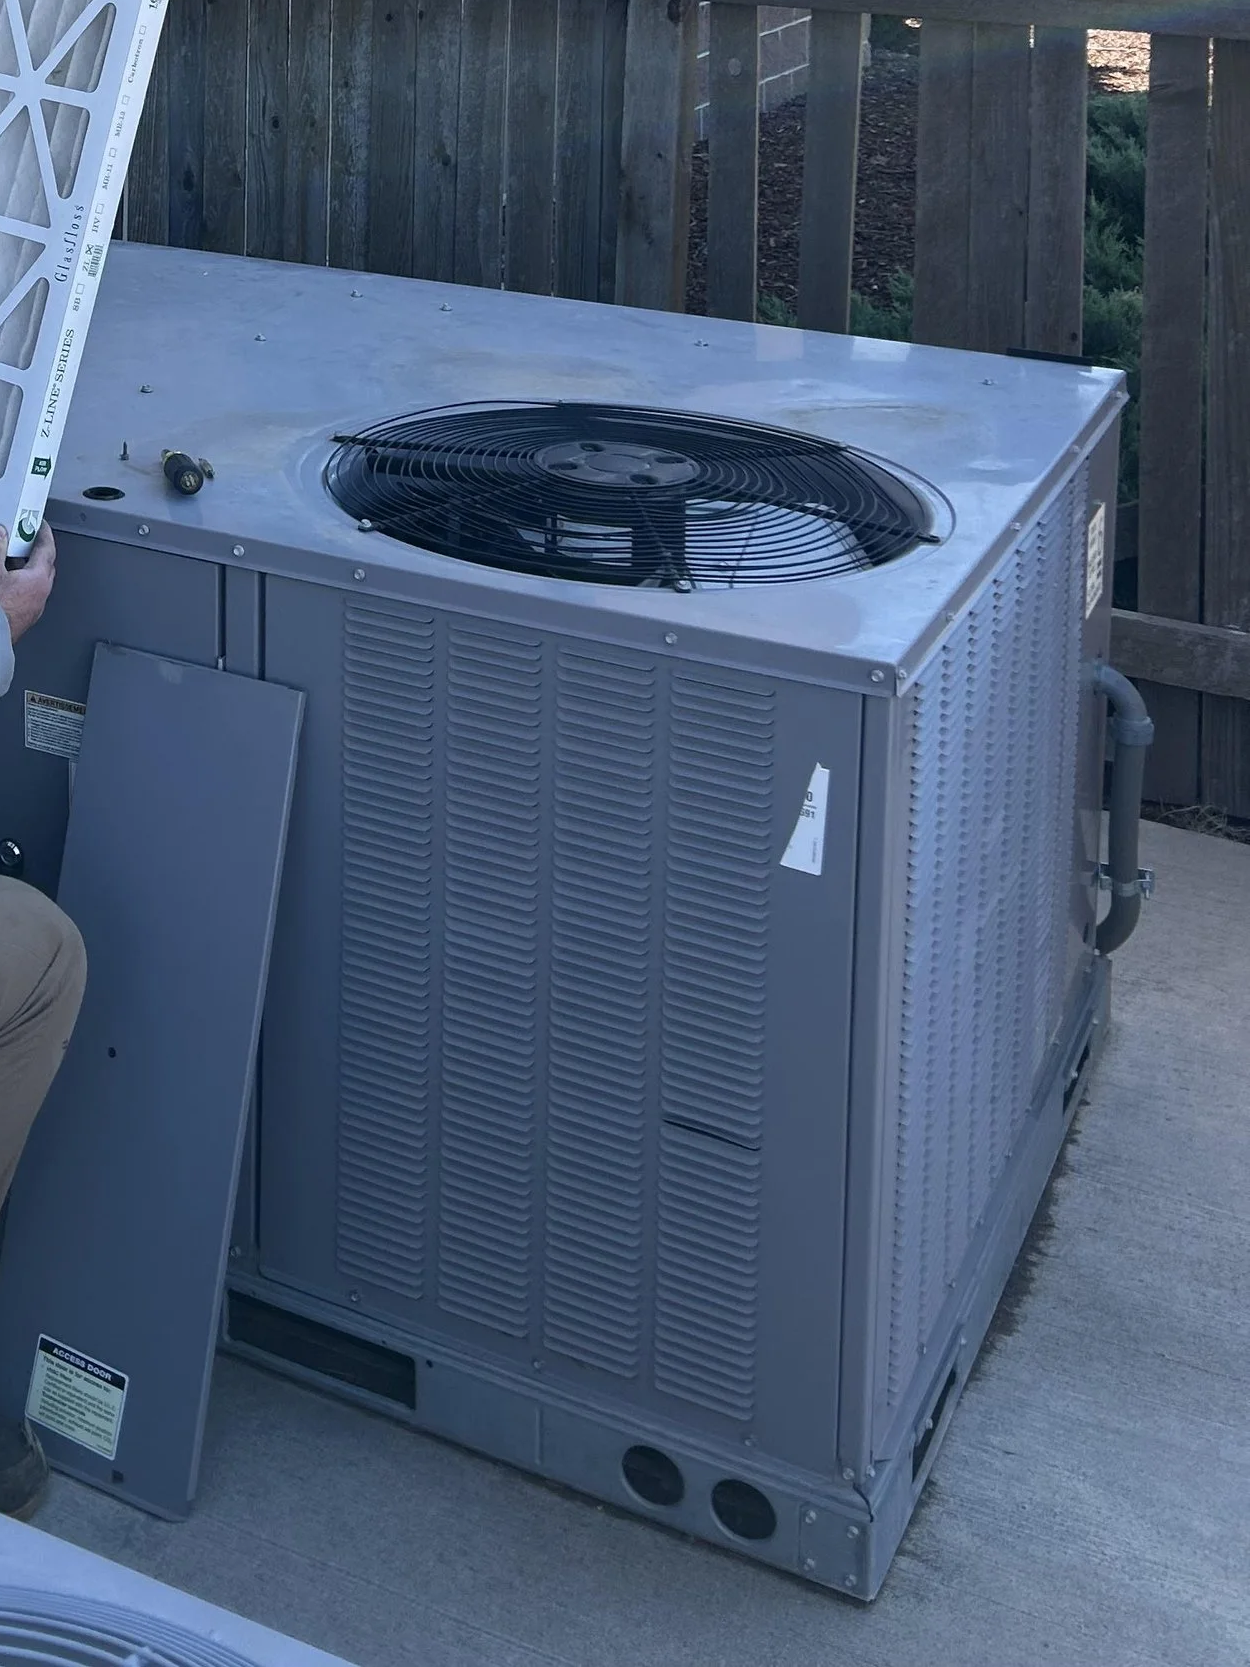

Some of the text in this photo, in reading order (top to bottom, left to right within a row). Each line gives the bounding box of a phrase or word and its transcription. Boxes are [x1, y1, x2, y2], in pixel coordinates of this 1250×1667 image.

[53, 204, 85, 283] Glasfloss
[55, 327, 75, 383] SERIES
[37, 696, 88, 715] AVERTISSEME
[52, 1347, 113, 1383] ACCESS DOOR
